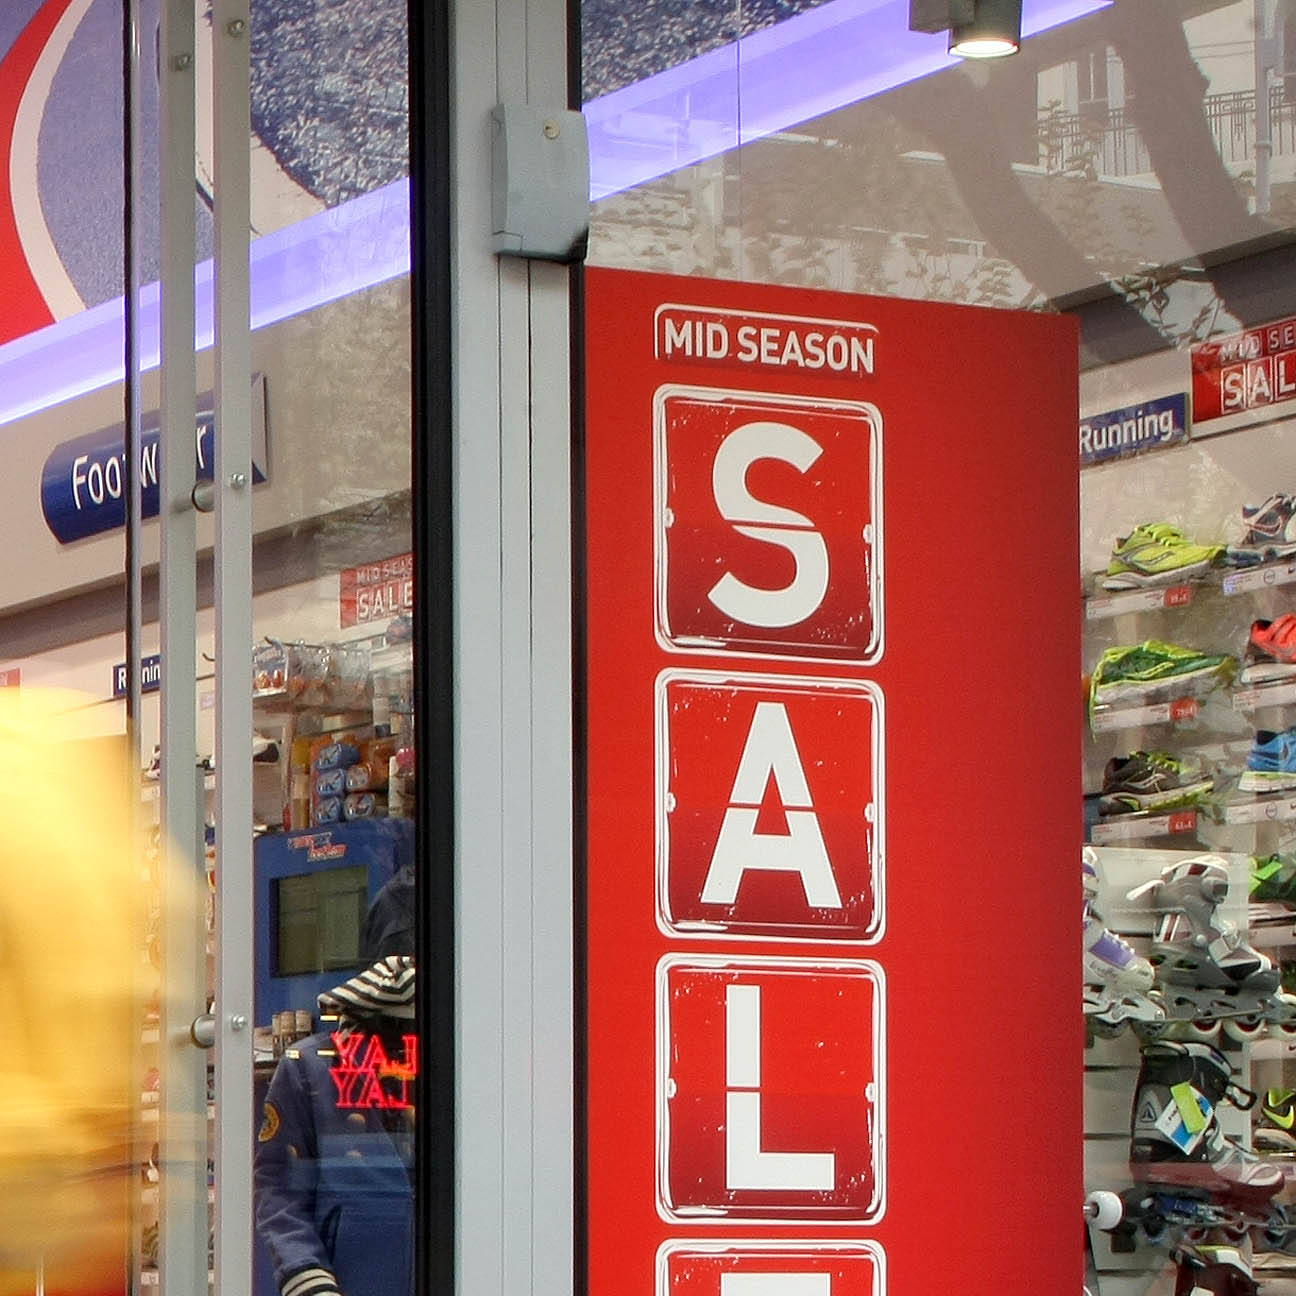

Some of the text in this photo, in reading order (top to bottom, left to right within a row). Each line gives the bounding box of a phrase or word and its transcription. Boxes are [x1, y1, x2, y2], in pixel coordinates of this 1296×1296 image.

[664, 318, 875, 373] MID SEASON
[1219, 334, 1260, 361] MID
[1223, 358, 1296, 407] SAL
[1080, 409, 1174, 454] Running
[71, 425, 208, 510] Foowr
[359, 580, 412, 618] SALE
[118, 660, 160, 691] Rnin
